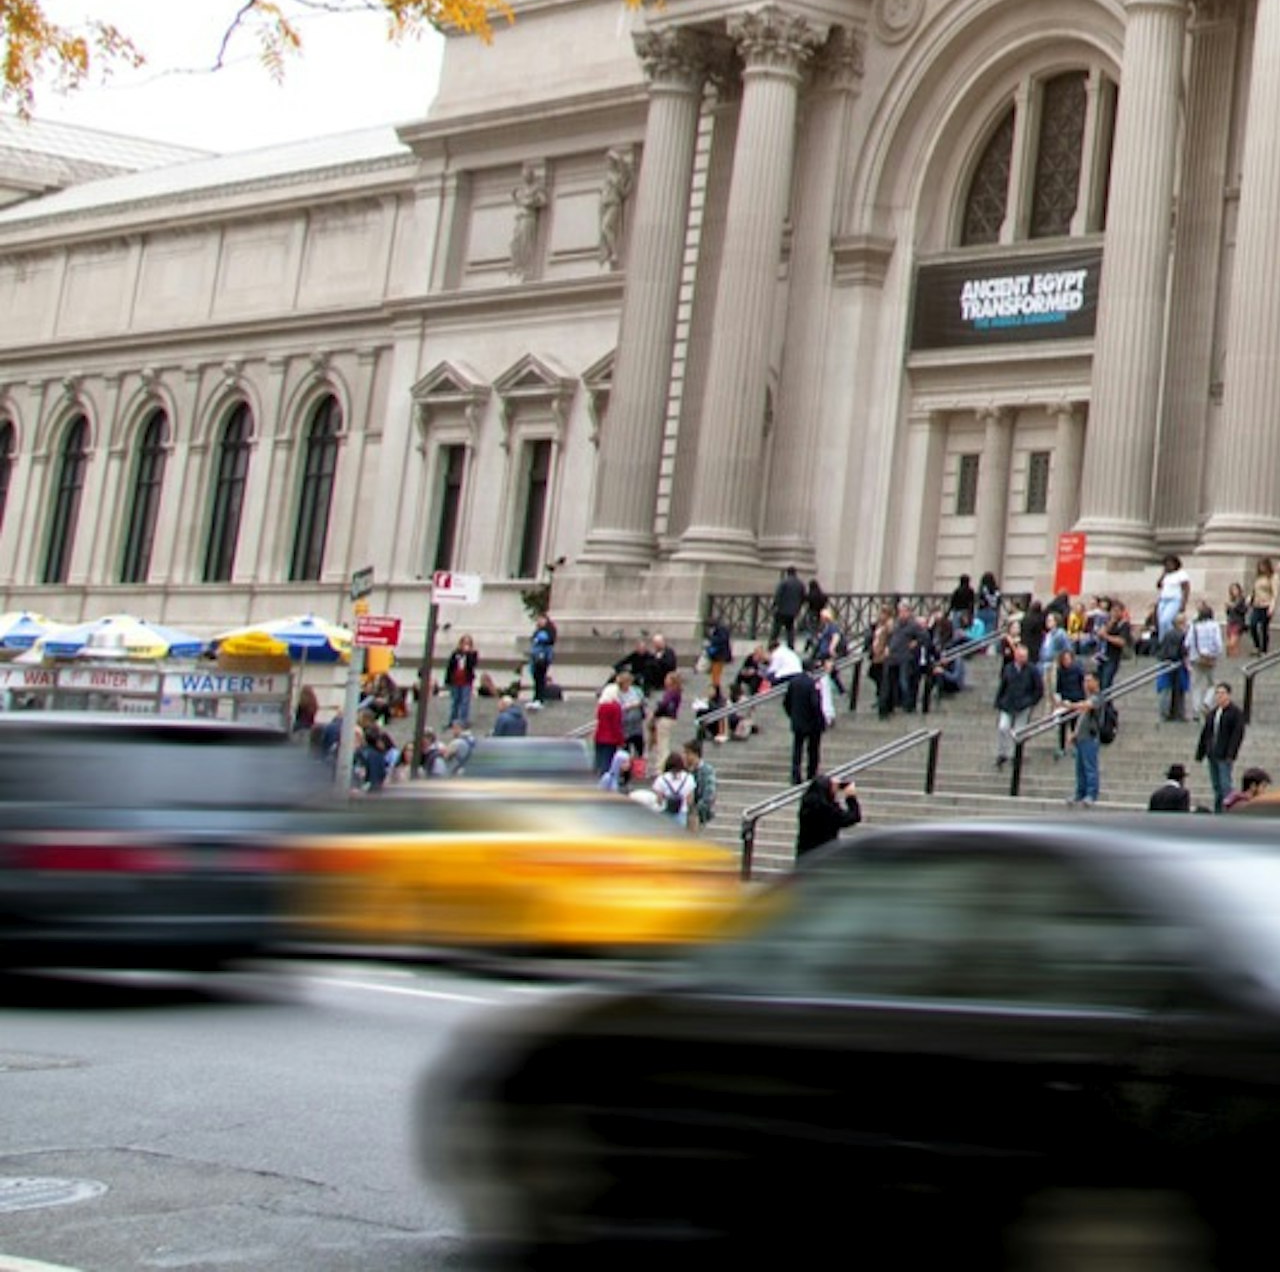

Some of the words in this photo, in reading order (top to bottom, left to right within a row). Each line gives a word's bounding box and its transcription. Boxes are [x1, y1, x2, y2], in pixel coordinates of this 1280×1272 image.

[961, 276, 1031, 300] ANCIENT
[1032, 269, 1088, 295] EGYPT
[961, 291, 1084, 320] TRANSFORMED
[181, 675, 254, 692] WATER
